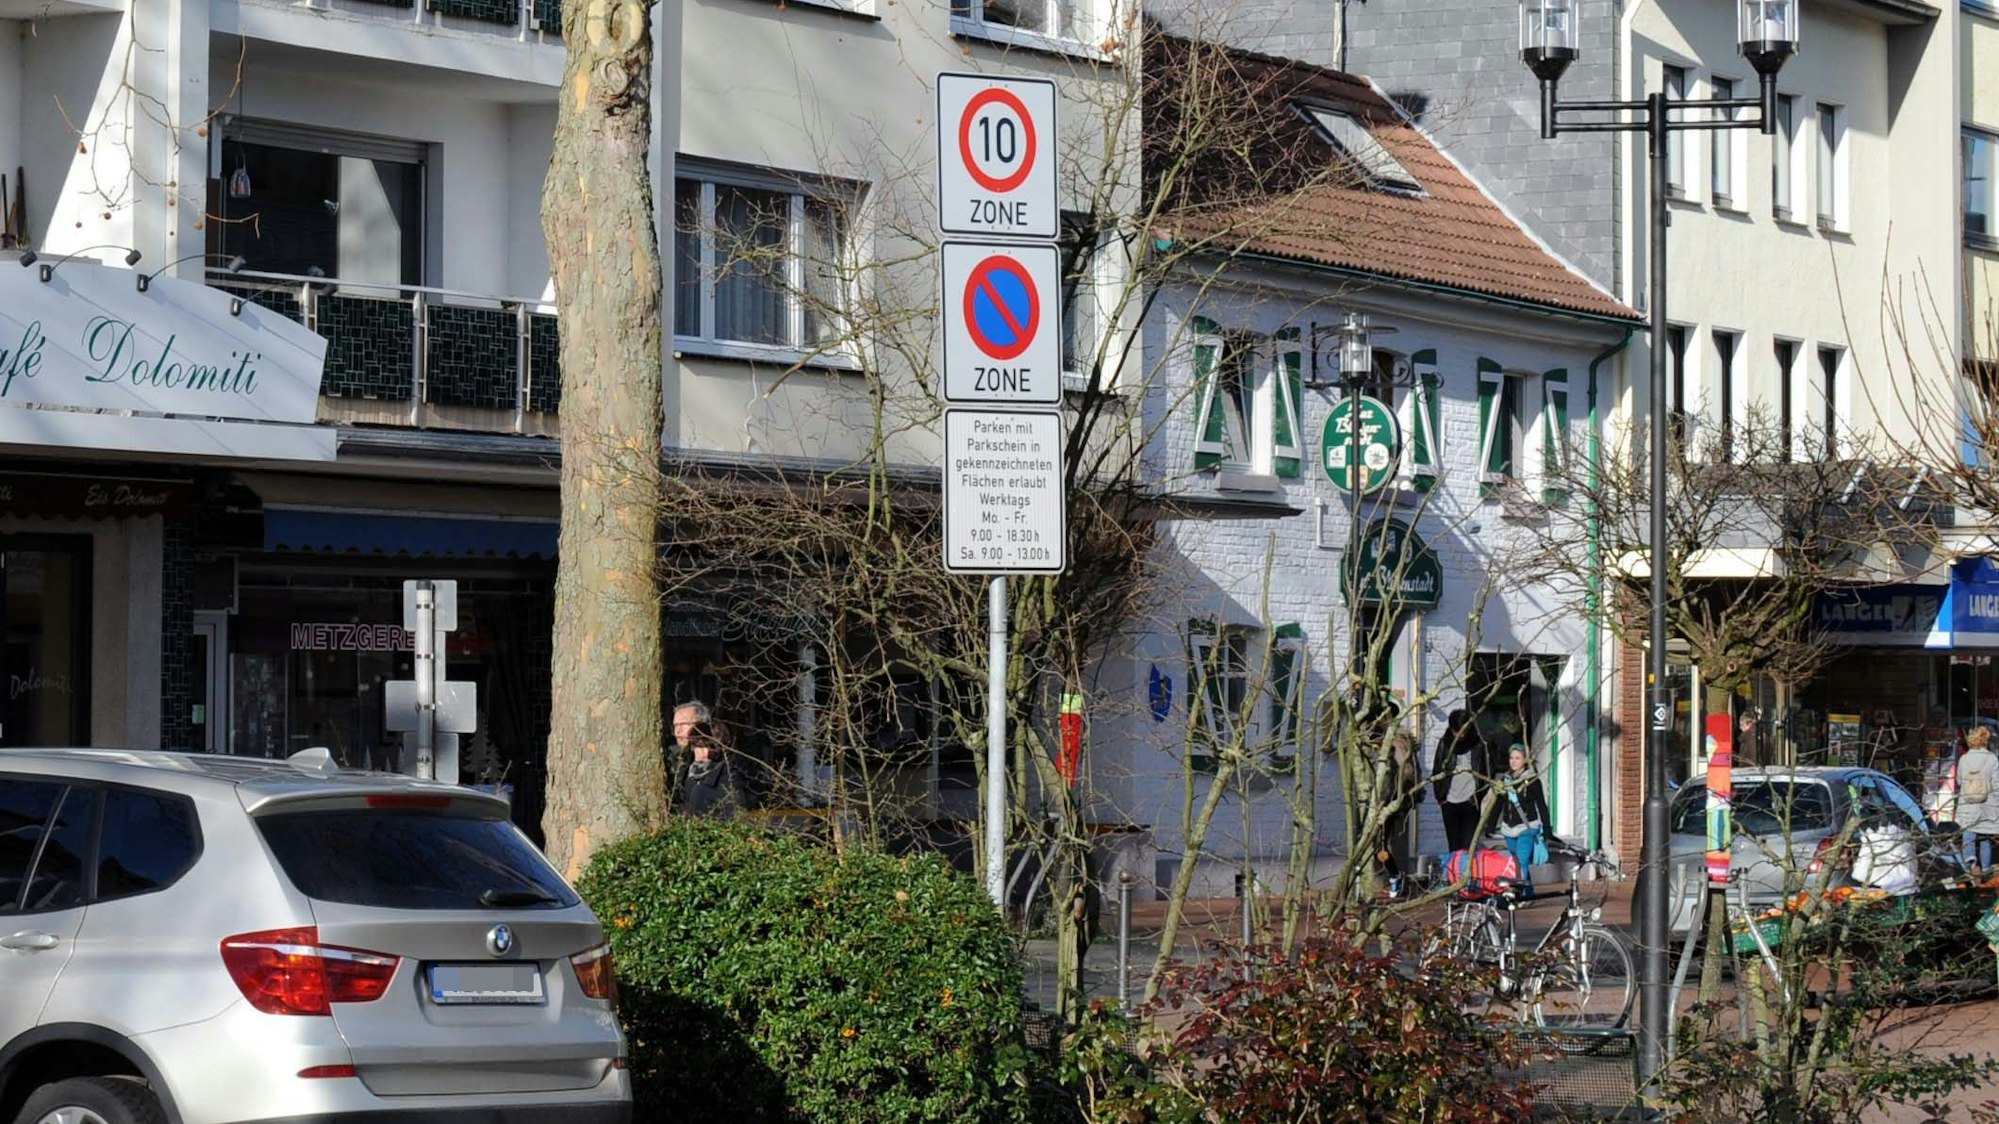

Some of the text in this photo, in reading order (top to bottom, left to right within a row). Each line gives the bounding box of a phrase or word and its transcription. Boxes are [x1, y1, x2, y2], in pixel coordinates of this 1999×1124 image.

[979, 116, 1016, 163] 10
[970, 200, 1028, 226] ZONE
[82, 316, 264, 394] Dolomiti
[974, 368, 1031, 392] ZONE
[974, 420, 1033, 435] Parken mit
[967, 438, 1041, 453] Parkschein in
[956, 457, 1052, 472] gekennzeichneten
[962, 474, 1047, 489] Flächen erlaubt
[980, 493, 1031, 509] Werktags
[982, 511, 1000, 524] Mo.
[1014, 511, 1028, 524] Fr.
[970, 529, 992, 542] 9.00
[1007, 529, 1032, 542] 18.30
[960, 547, 977, 560] Sa.
[981, 547, 1003, 560] 9.00
[1017, 547, 1043, 560] 13.00
[290, 622, 416, 651] METZGERE
